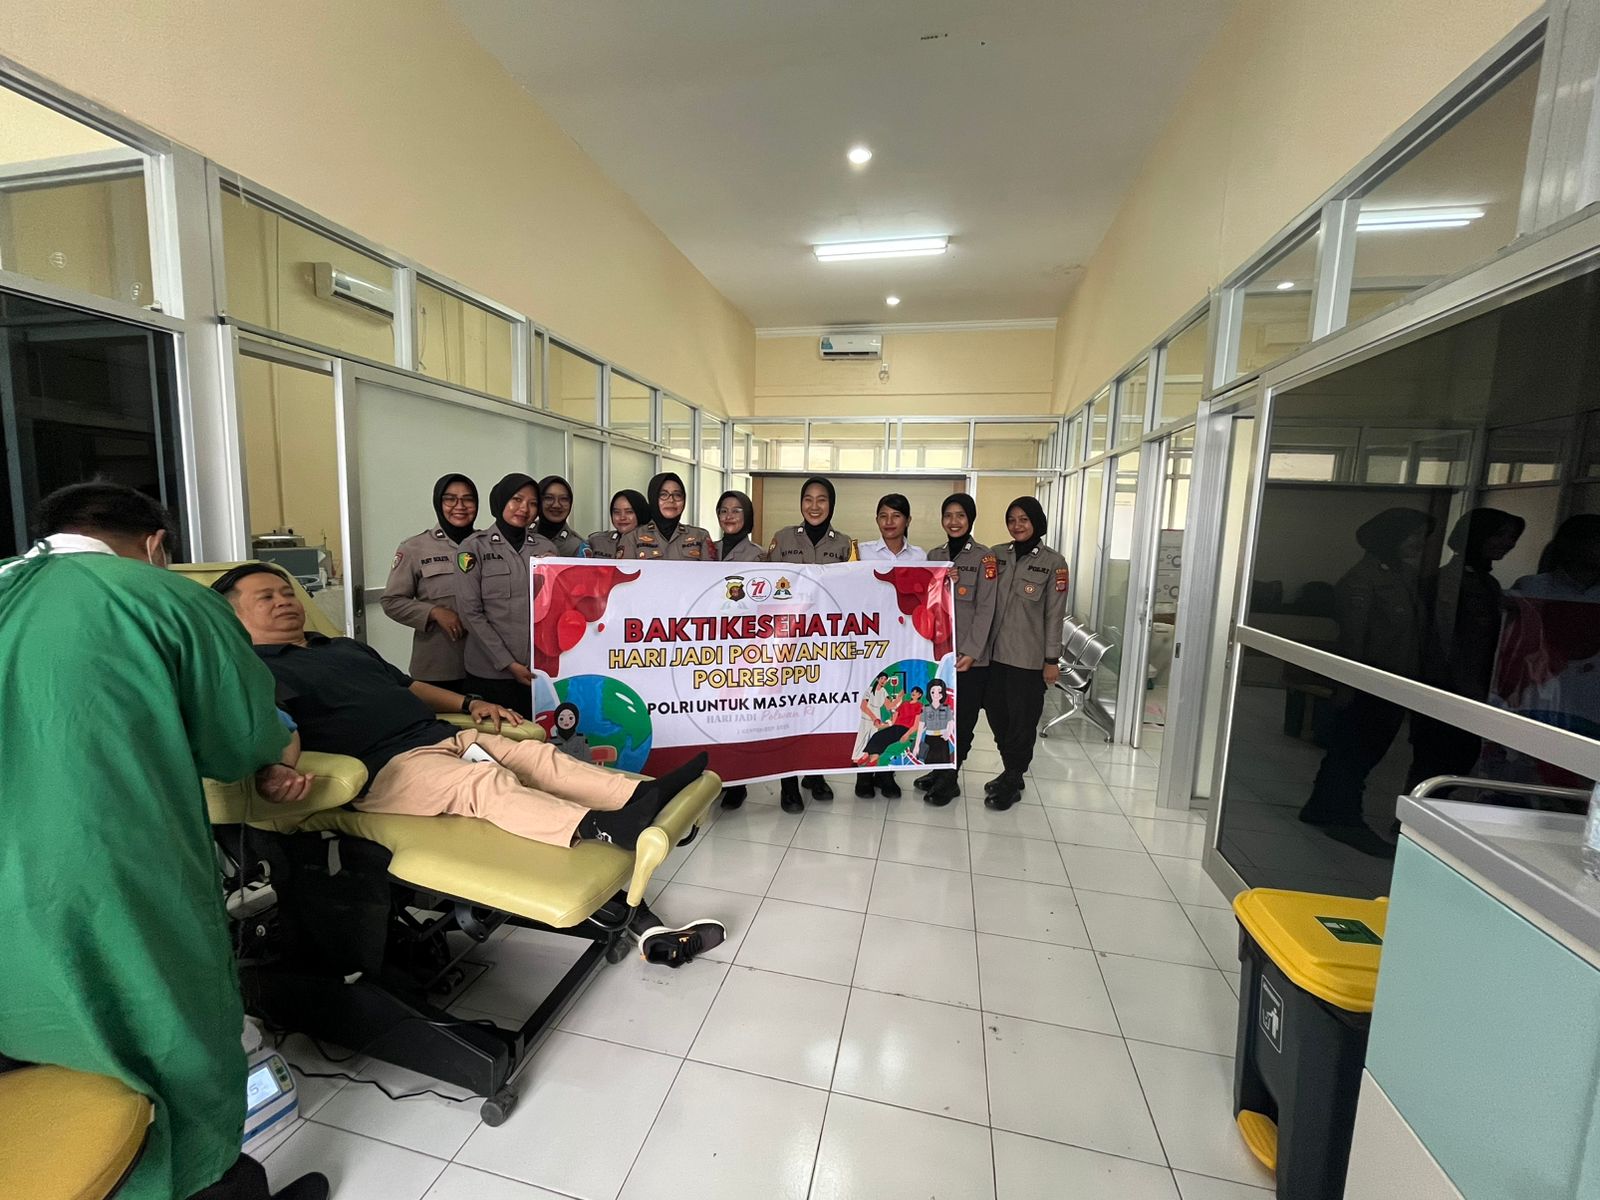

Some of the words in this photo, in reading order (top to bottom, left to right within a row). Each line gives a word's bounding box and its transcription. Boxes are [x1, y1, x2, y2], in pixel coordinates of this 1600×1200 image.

[957, 565, 978, 573] POLRI
[1027, 564, 1050, 575] POLRI
[624, 616, 716, 643] BAKTI
[720, 612, 881, 640] KESEHATAN
[608, 648, 667, 669] HARI
[670, 645, 722, 667] JADI
[729, 642, 829, 665] POLWAN
[830, 640, 890, 661] KE-77
[693, 667, 779, 689] POLRES
[780, 664, 821, 684] PPU
[648, 701, 693, 715] POLRI
[697, 698, 750, 713] UNTUK
[753, 691, 860, 710] MASYARAKAT
[706, 714, 732, 725] HARI
[732, 712, 757, 723] JADI
[760, 708, 800, 722] Polwan
